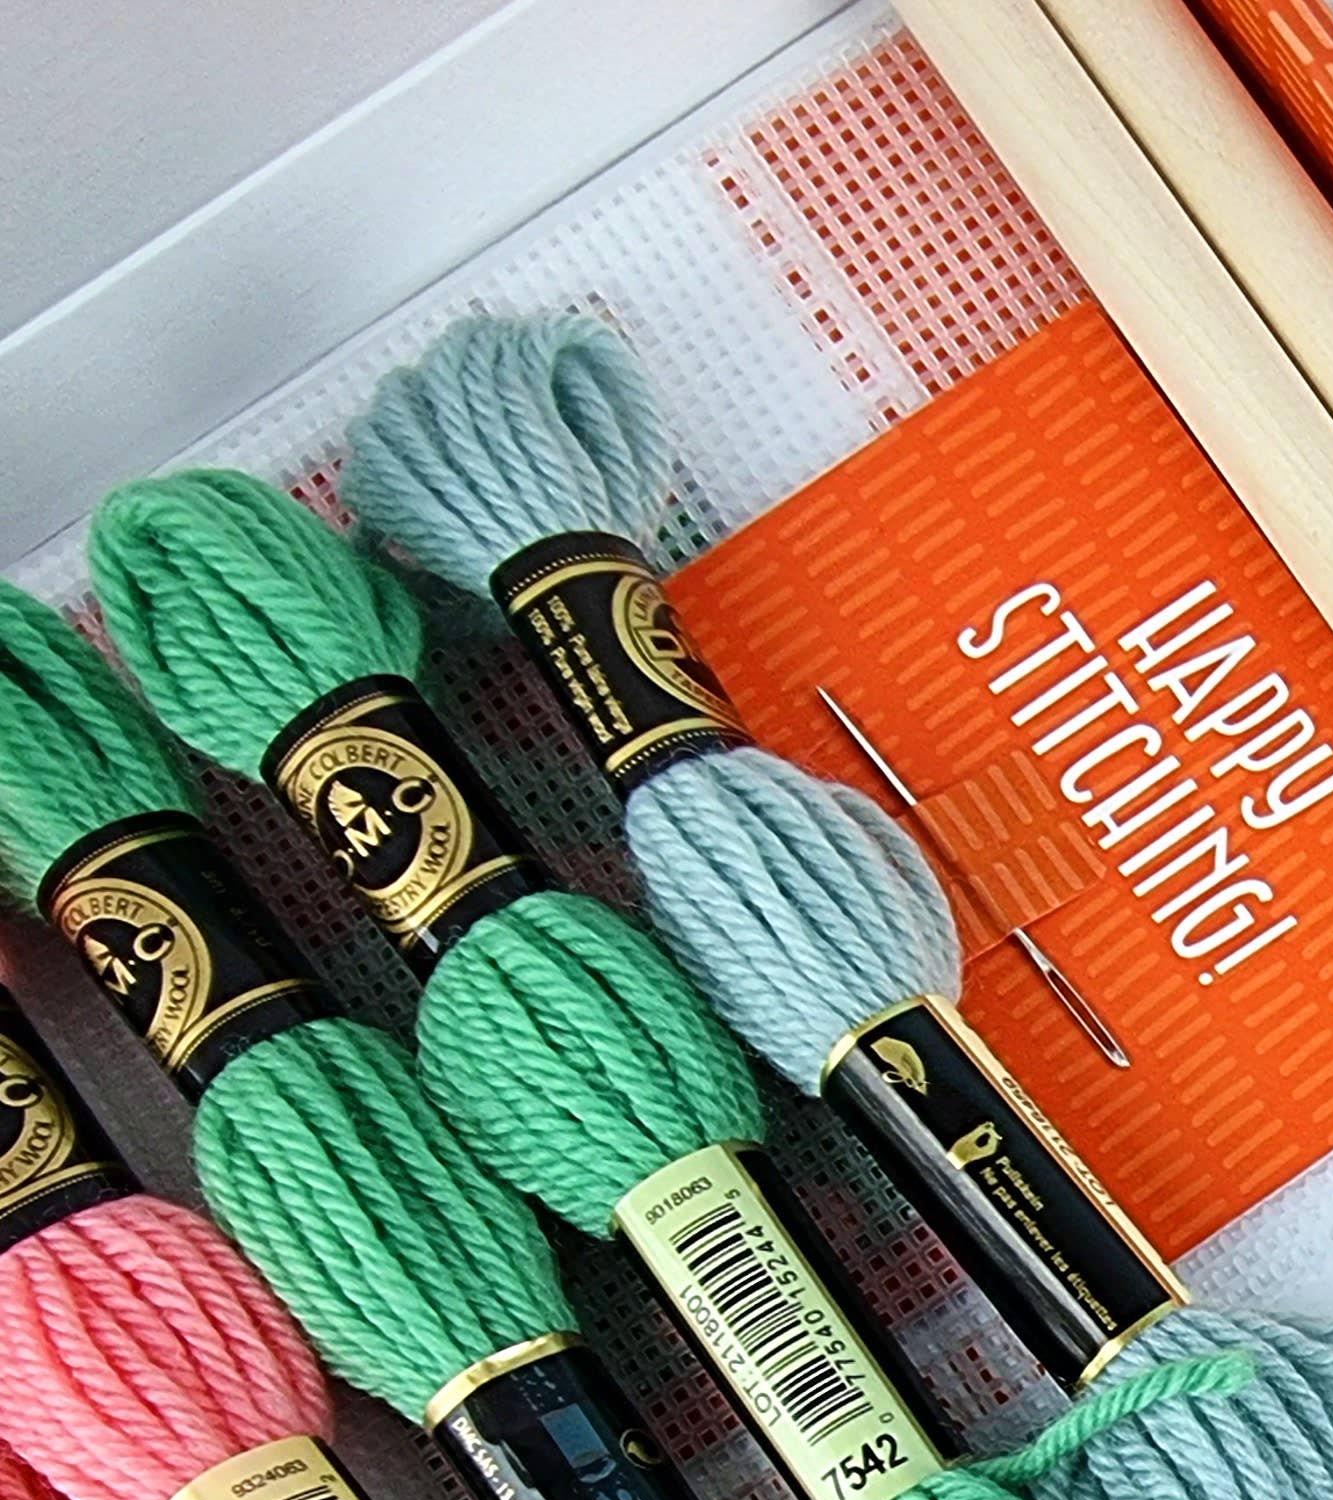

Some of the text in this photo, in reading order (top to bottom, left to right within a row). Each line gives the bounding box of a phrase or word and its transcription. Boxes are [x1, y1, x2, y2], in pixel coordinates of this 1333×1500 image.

[528, 608, 556, 646] 100%
[550, 646, 574, 679] Pure
[547, 595, 576, 632] 100%
[569, 633, 593, 666] Pure
[309, 744, 406, 780] COLBERT
[957, 583, 1297, 985] STITCHING!
[420, 821, 451, 874] WOOL
[164, 964, 191, 1019] WOOL
[15, 1121, 55, 1166] WOOL
[645, 1176, 713, 1225] 9018063
[992, 1186, 1017, 1209] pas
[1014, 1210, 1054, 1252] enlever
[744, 1225, 806, 1301] 15244
[679, 1283, 746, 1370] 2118001
[804, 1309, 866, 1387] 77540
[231, 1459, 308, 1498] 9324063
[451, 1416, 481, 1452] DMC
[472, 1449, 499, 1478] SAS
